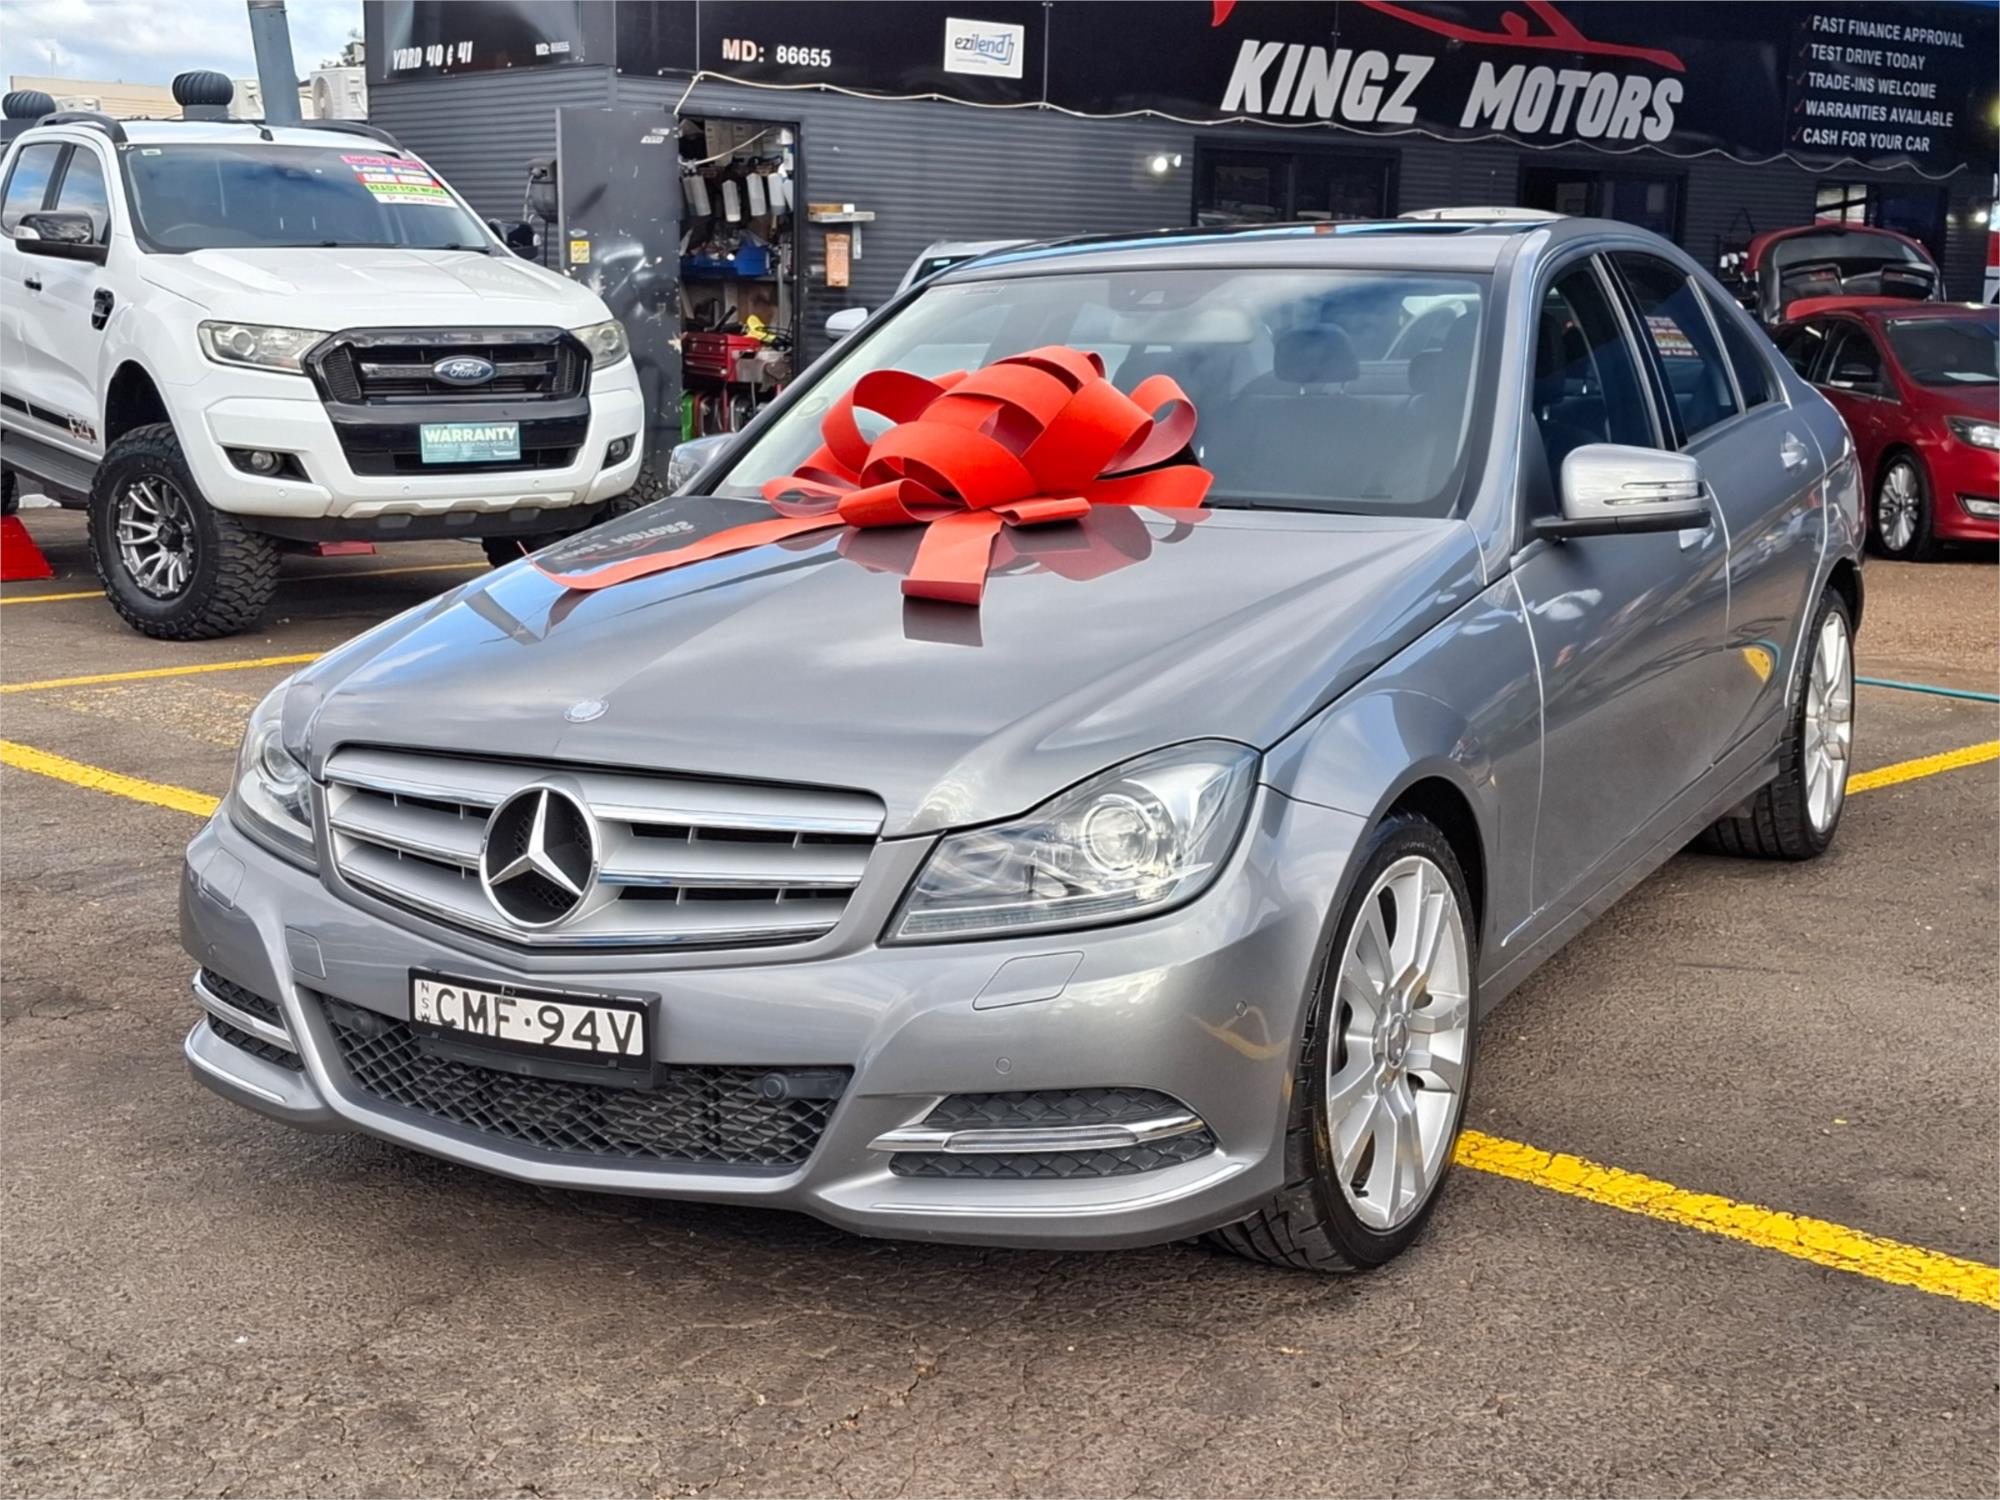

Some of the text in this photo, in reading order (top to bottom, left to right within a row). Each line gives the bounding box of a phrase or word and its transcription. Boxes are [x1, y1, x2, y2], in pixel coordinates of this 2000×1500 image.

[955, 33, 1007, 54] ezilend
[1812, 15, 1965, 48] FAST FINANCE APPROVAL
[393, 47, 422, 70] YARD
[426, 44, 443, 67] 40
[457, 41, 473, 63] 41
[722, 38, 831, 67] MD: 86655
[1811, 44, 1926, 70] TEST DRIVE TODAY
[1220, 39, 1684, 143] KINGZ MOTORS
[1808, 71, 1937, 99] TRADE-INS WELCOME
[1805, 100, 1953, 127] WARRANTIES AVAILABLE
[1803, 128, 1930, 152] CASH FOR YOUR CAR
[449, 362, 482, 377] Ford
[424, 427, 516, 443] WARRANTY
